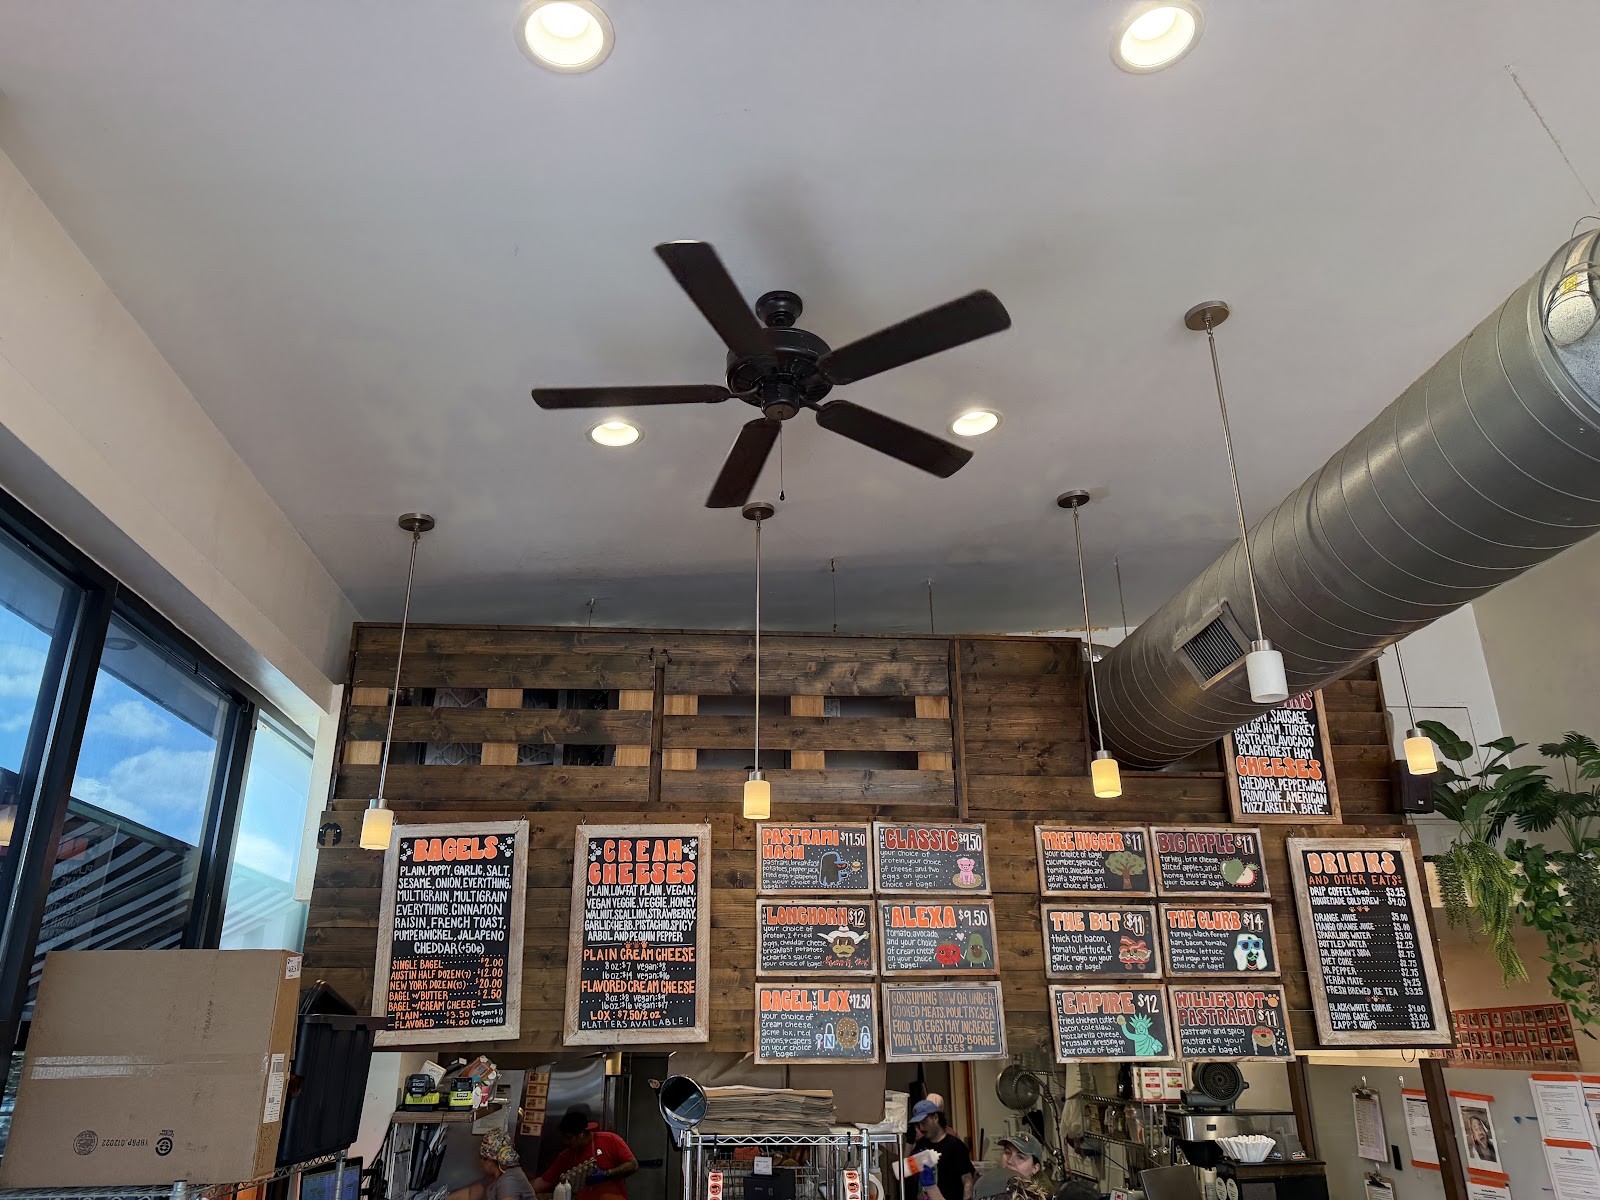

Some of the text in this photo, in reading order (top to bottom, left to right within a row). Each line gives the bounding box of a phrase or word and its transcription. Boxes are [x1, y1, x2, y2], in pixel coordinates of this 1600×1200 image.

[1271, 709, 1308, 724] SAUSAGE
[1283, 724, 1315, 736] TURKEY
[1278, 734, 1314, 748] AVOCADO
[1239, 744, 1313, 759] BLACK FOREST HAM
[1236, 756, 1322, 780] CHEESES
[1286, 791, 1327, 805] AMERICAN
[762, 828, 865, 846] PASTRAMI $11.50
[885, 828, 959, 852] CLASSIC
[958, 832, 981, 851] $9.50
[1042, 832, 1143, 851] TREE HUGGER $11
[413, 836, 499, 863] BAGELS
[1157, 833, 1255, 855] BIG APPLE $11
[603, 839, 683, 863] CREAM
[763, 845, 804, 859] HASH
[1307, 852, 1397, 874] DRINKS
[487, 865, 510, 877] SALT,
[588, 862, 696, 885] CHEESES
[398, 877, 435, 889] SESAME,
[1309, 874, 1329, 884] AND
[1334, 875, 1366, 885] OTHER
[1328, 887, 1351, 895] COFFEE
[1386, 887, 1406, 897] $3.25
[452, 903, 502, 916] CINNAMON
[431, 917, 470, 928] FRENCH
[474, 916, 506, 929] TOAST,
[767, 906, 866, 927] LONGHORN $12
[891, 906, 988, 928] ALEXA $9.50
[1167, 910, 1264, 931] THE CLURB $14
[1050, 912, 1144, 935] THE BLT $11
[458, 930, 504, 941] JALAPENO
[588, 931, 683, 943] ARBOL AND PEQUIN PEPPER
[1051, 934, 1107, 943] thick cut bacon,
[1317, 931, 1413, 940] SPARKLING WATER $3.00
[414, 942, 458, 954] CHEDDAR
[1319, 940, 1346, 948] BOTTLED
[1347, 940, 1367, 948] WATER
[584, 948, 695, 962] PLAIN CREAM CHEESE
[392, 958, 503, 970] SINGLE BAGEL $2.00
[390, 970, 415, 980] AUSTIN
[417, 970, 436, 979] HALF
[477, 969, 503, 977] $12.00
[390, 980, 407, 990] NEW
[409, 980, 427, 989] YORK
[475, 978, 503, 989] $20.00
[581, 980, 695, 995] FLAVORED CREAM CHEESE
[1327, 986, 1347, 995] FRESH
[1348, 986, 1371, 995] BREWED
[1373, 987, 1384, 995] ICE
[1385, 987, 1398, 996] TEA
[761, 990, 812, 1012] BAGEL
[818, 990, 851, 1012] LOX
[849, 994, 870, 1009] $12.50
[1062, 992, 1159, 1014] EMPIRE $12
[1176, 992, 1265, 1008] WILLIE'S HOT
[396, 1010, 470, 1020] PLAIN $3.50
[892, 1006, 919, 1017] COOKED
[981, 1007, 994, 1019] SEA
[1178, 1008, 1279, 1027] PASTRAMI $11
[1331, 1012, 1428, 1021] CRUMB CAKE $3.00
[395, 1019, 434, 1029] FLAVORED
[581, 1018, 689, 1029] PLATTERS AVAILABLE!
[892, 1020, 995, 1035] FOOD, OR EGGS MAY INCREASE
[1333, 1021, 1430, 1029] ZAPP'S CHIPS $2.00
[892, 1033, 912, 1047] YOUR
[914, 1033, 932, 1046] RISK
[934, 1034, 943, 1044] OF
[1224, 1038, 1245, 1046] your
[919, 1044, 965, 1053] ILLNESSES
[1183, 1046, 1206, 1054] choice
